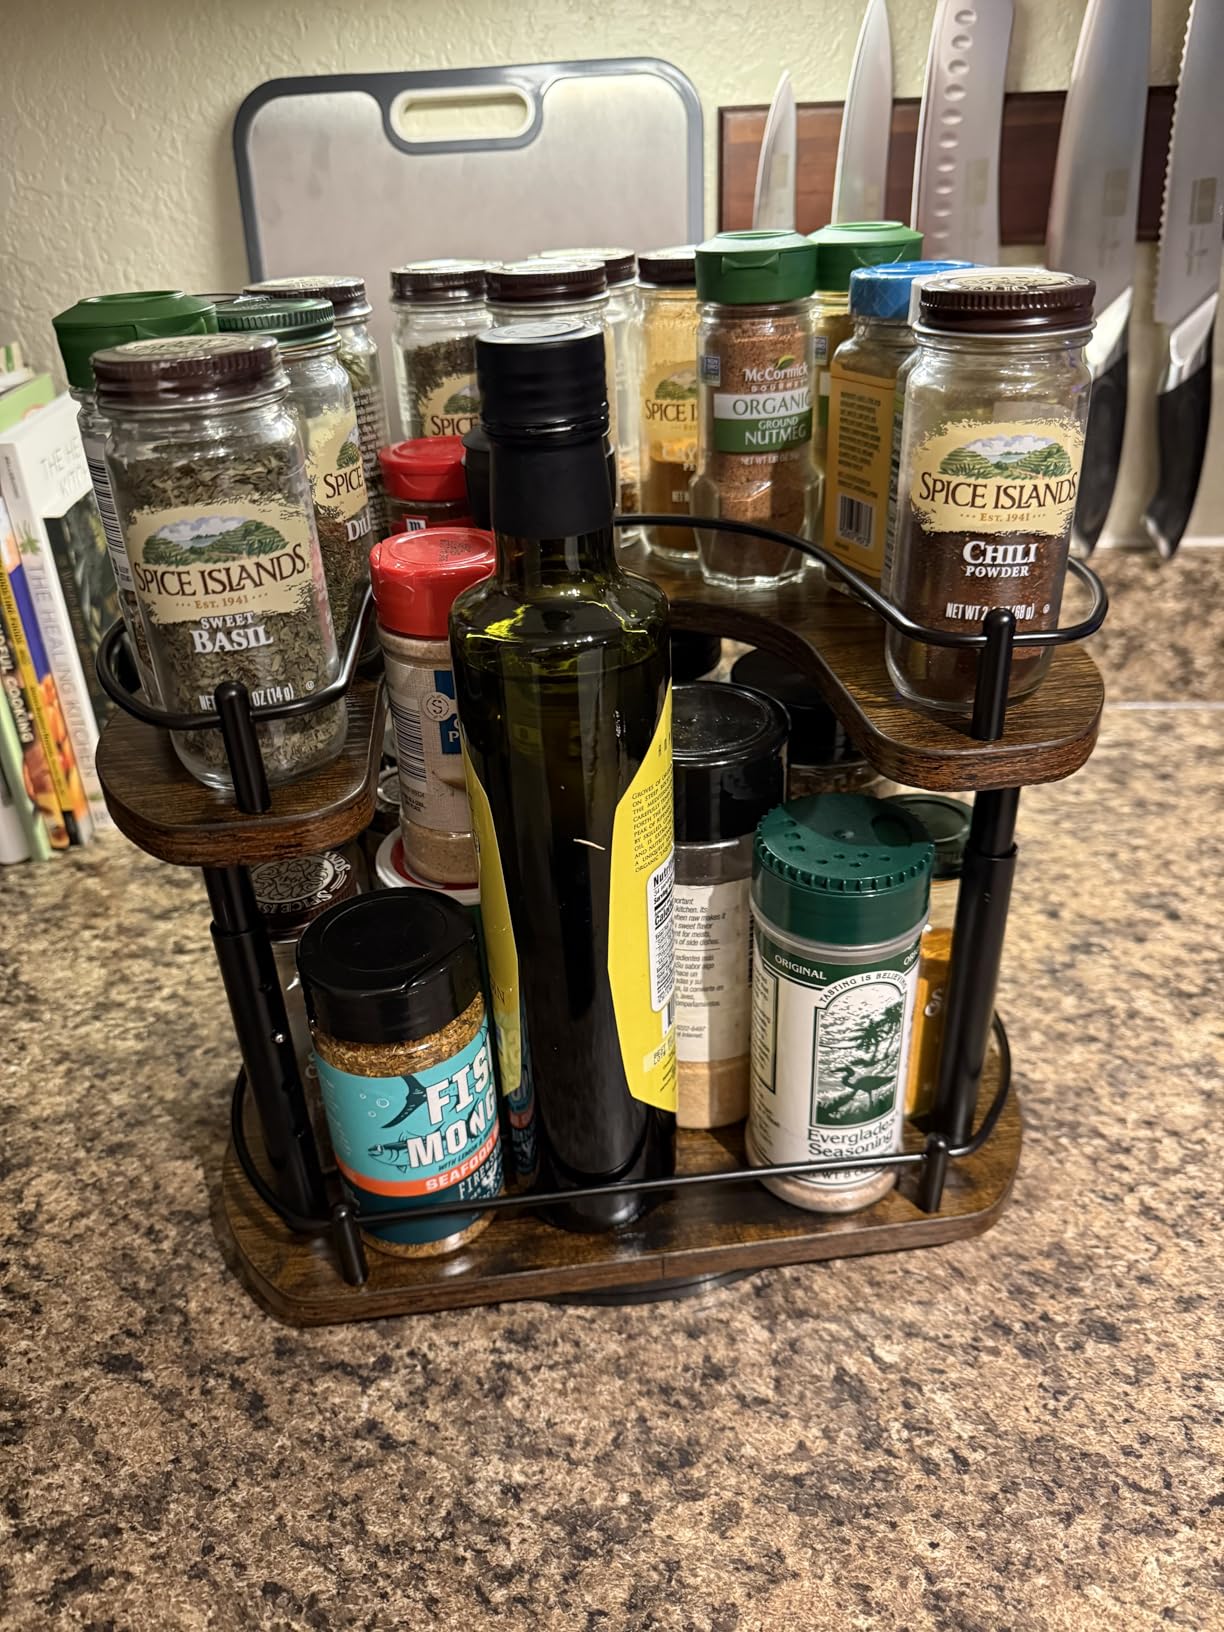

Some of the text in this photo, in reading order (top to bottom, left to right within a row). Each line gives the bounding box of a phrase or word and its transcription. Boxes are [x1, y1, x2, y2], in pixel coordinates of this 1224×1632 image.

[742, 361, 809, 383] McCormick
[645, 399, 686, 423] SPICE
[732, 388, 811, 416] ORGANIC
[744, 424, 807, 446] NUTMEG
[758, 416, 799, 430] GROUND
[323, 467, 364, 499] SPICE
[919, 471, 988, 509] SPICE
[992, 471, 1078, 510] ISLANDS
[1005, 512, 1031, 522] 1941
[134, 562, 198, 598] SPICE
[198, 544, 306, 595] ISLANDS
[964, 564, 1031, 578] POWDER
[221, 593, 250, 608] 1941
[945, 602, 965, 620] NET
[964, 604, 982, 621] WT
[200, 611, 255, 630] SWEET
[189, 625, 275, 655] BASIL
[40, 608, 77, 695] HEALING
[63, 701, 98, 779] KITCHEN
[251, 691, 267, 706] OZ
[6, 674, 35, 744] COOKING
[678, 922, 697, 931] sweet
[774, 954, 828, 981] ORIGINAL
[819, 977, 857, 1003] TASTING
[861, 972, 872, 983] IS
[807, 1116, 896, 1144] Everglades
[808, 1129, 894, 1158] Seasoning
[424, 1138, 495, 1191] SEAFOOD
